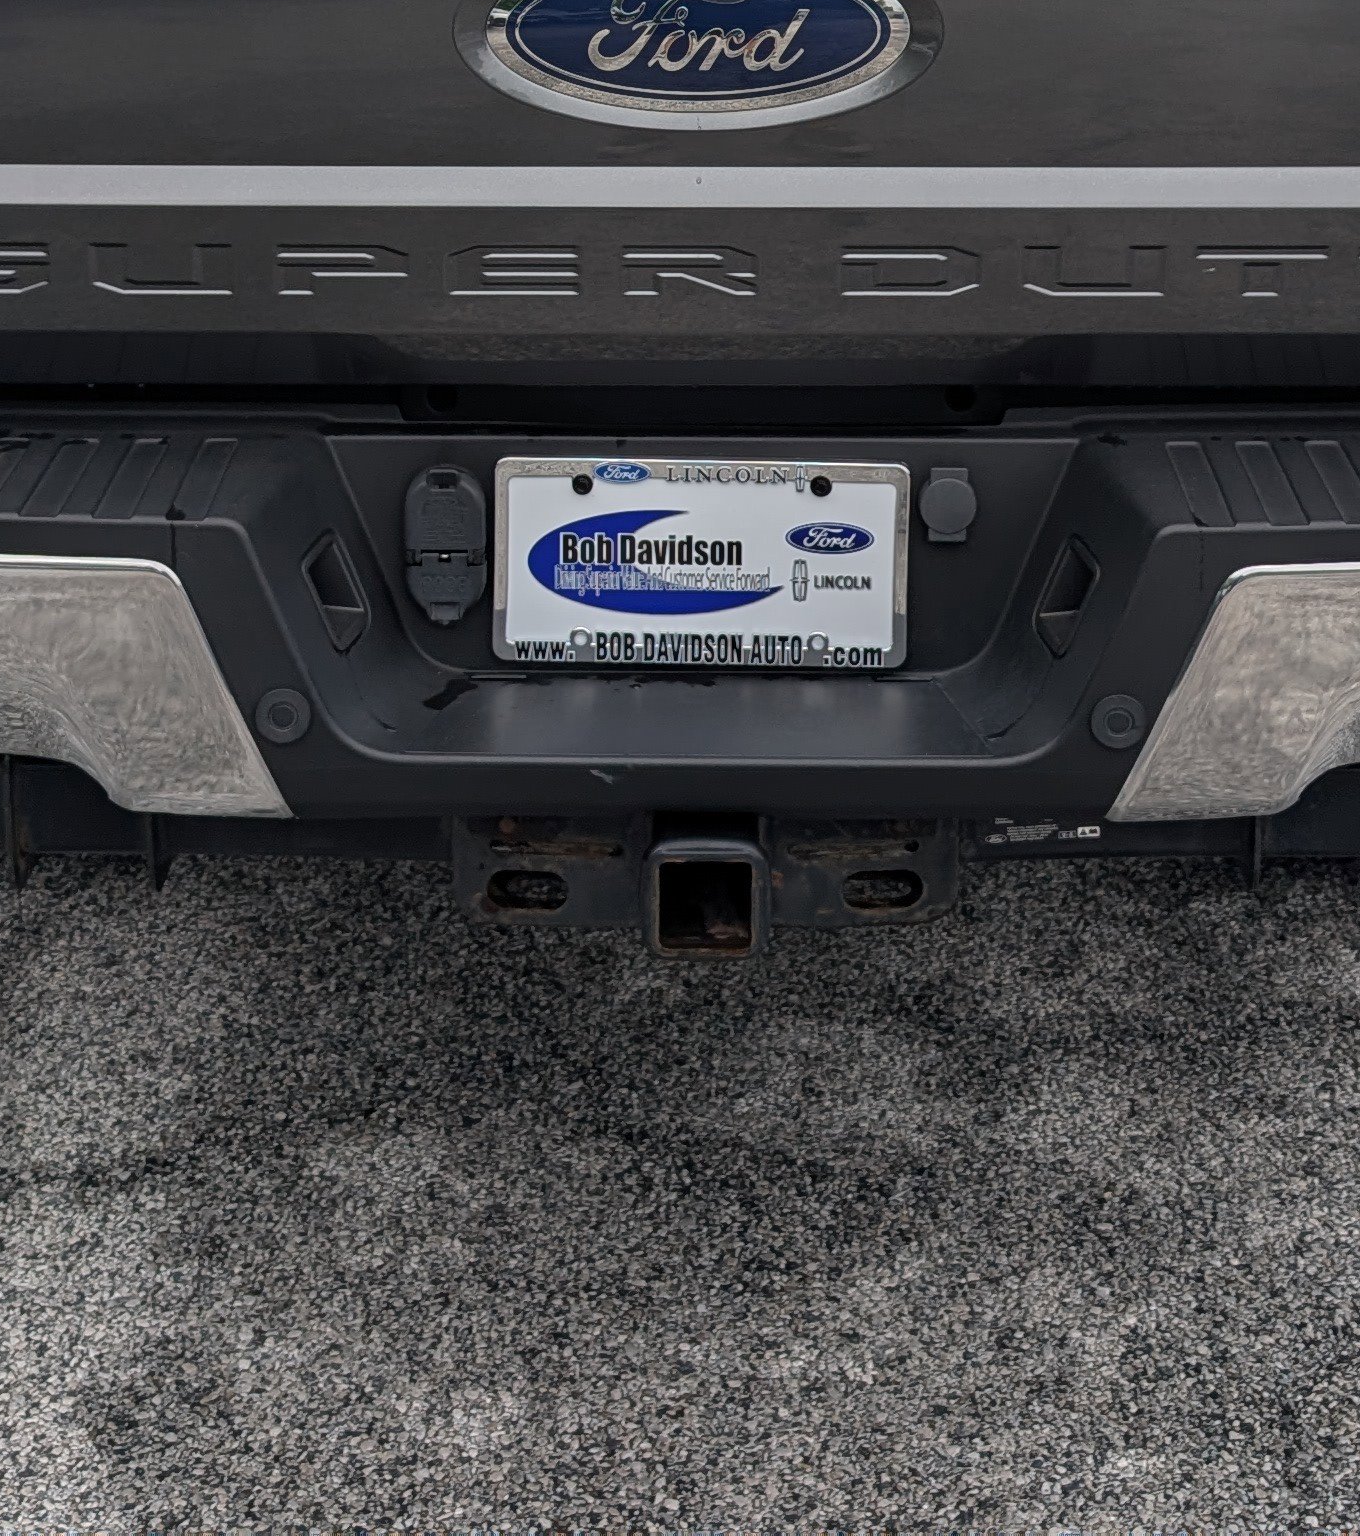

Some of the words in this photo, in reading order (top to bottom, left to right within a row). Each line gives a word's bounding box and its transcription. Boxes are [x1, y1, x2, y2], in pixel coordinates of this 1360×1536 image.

[603, 464, 640, 482] Ford
[665, 464, 790, 484] LINCOLN
[560, 532, 615, 565] Bob
[619, 533, 744, 566] Davidson
[802, 526, 857, 550] Ford
[665, 566, 704, 591] Customer
[705, 567, 735, 591] Service
[736, 567, 771, 592] Forward
[812, 574, 872, 591] LINCOLN
[514, 639, 577, 662] www.
[595, 631, 635, 663] BOB
[643, 632, 741, 664] DAVIDSON
[750, 633, 804, 665] AUTO
[822, 644, 885, 668] .com
